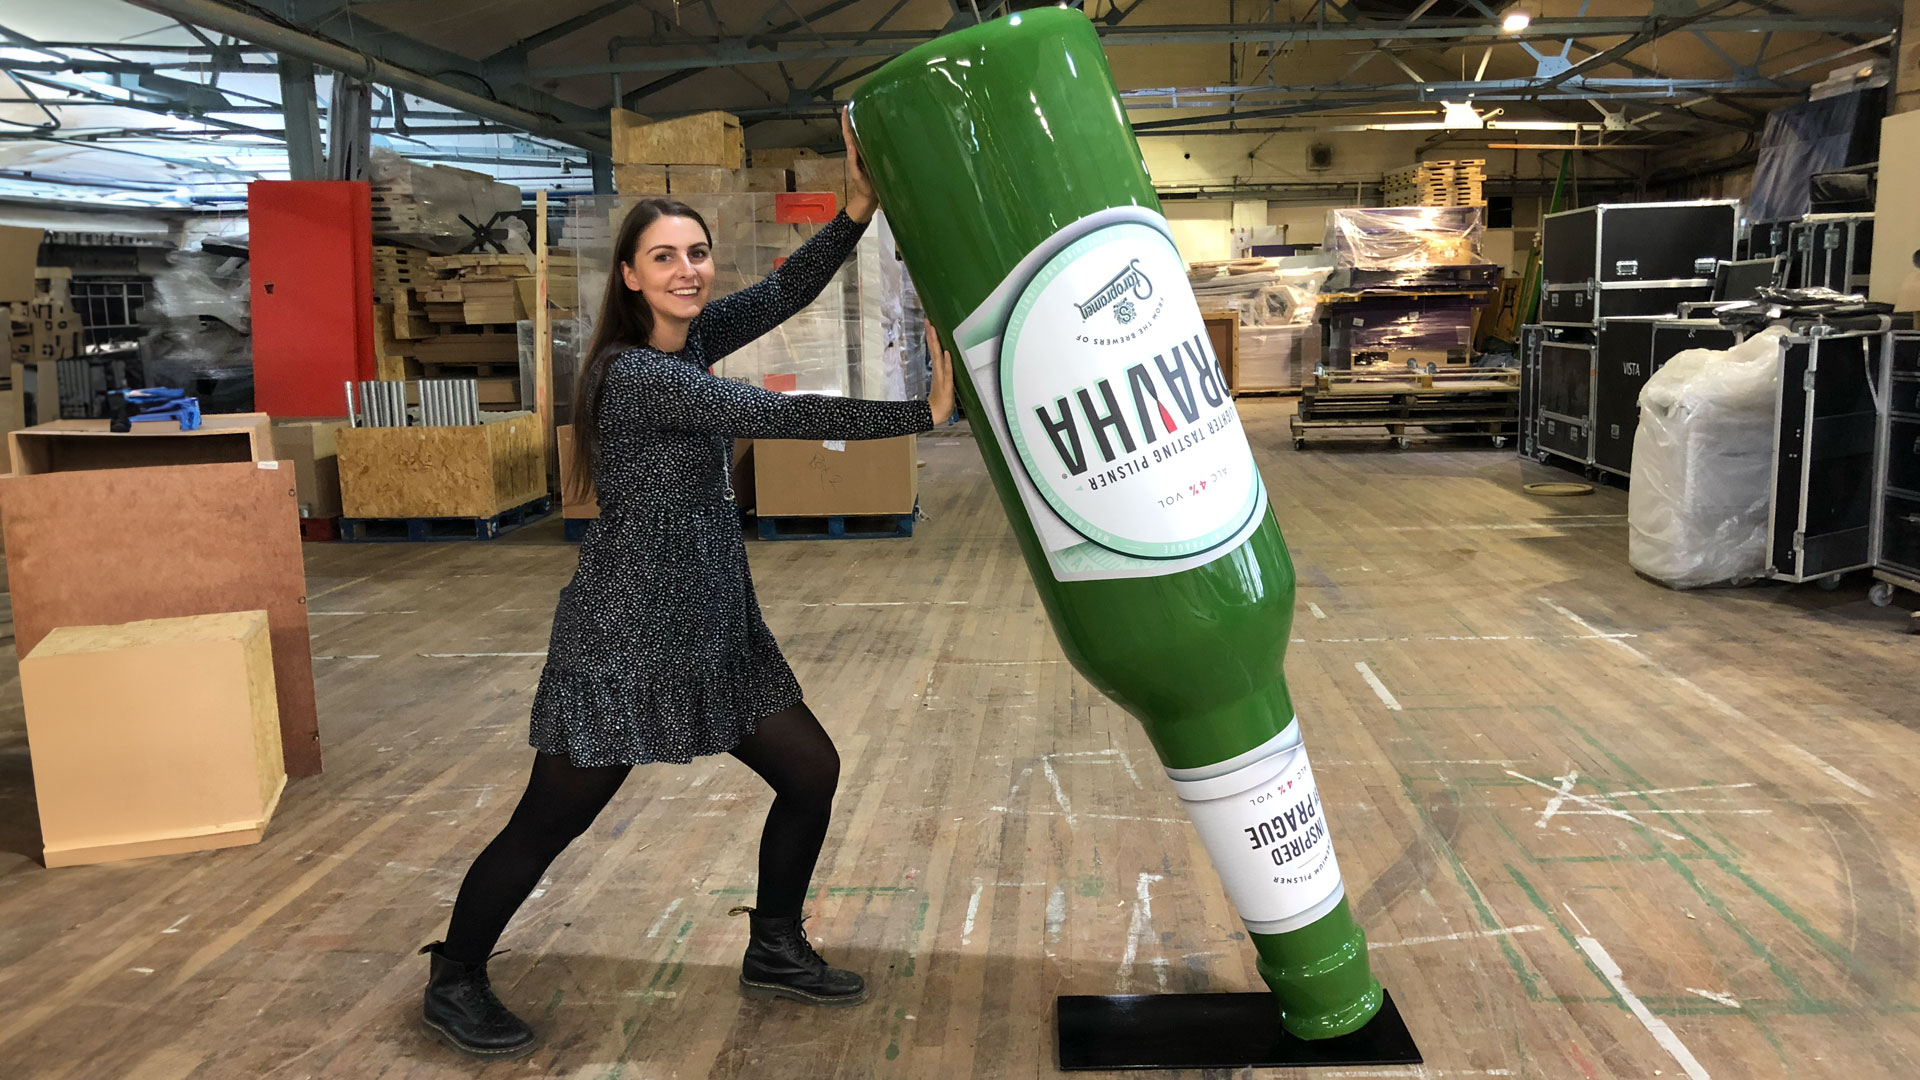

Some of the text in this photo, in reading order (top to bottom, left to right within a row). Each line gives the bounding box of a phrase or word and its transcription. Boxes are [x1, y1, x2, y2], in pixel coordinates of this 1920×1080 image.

[1073, 258, 1153, 320] Staropramen
[1076, 297, 1165, 345] FROM THE BREWERS OF
[1622, 361, 1641, 377] VISTA
[1034, 328, 1231, 476] PRAVHA
[1153, 427, 1206, 463] TASTING
[1088, 455, 1150, 491] PILSNER
[1157, 467, 1228, 508] ALC 4% VOL
[1250, 792, 1274, 806] VOL
[1244, 793, 1316, 851] PRAGUE
[1271, 816, 1326, 867] INSPIRED
[1273, 873, 1313, 884] PILSNER
